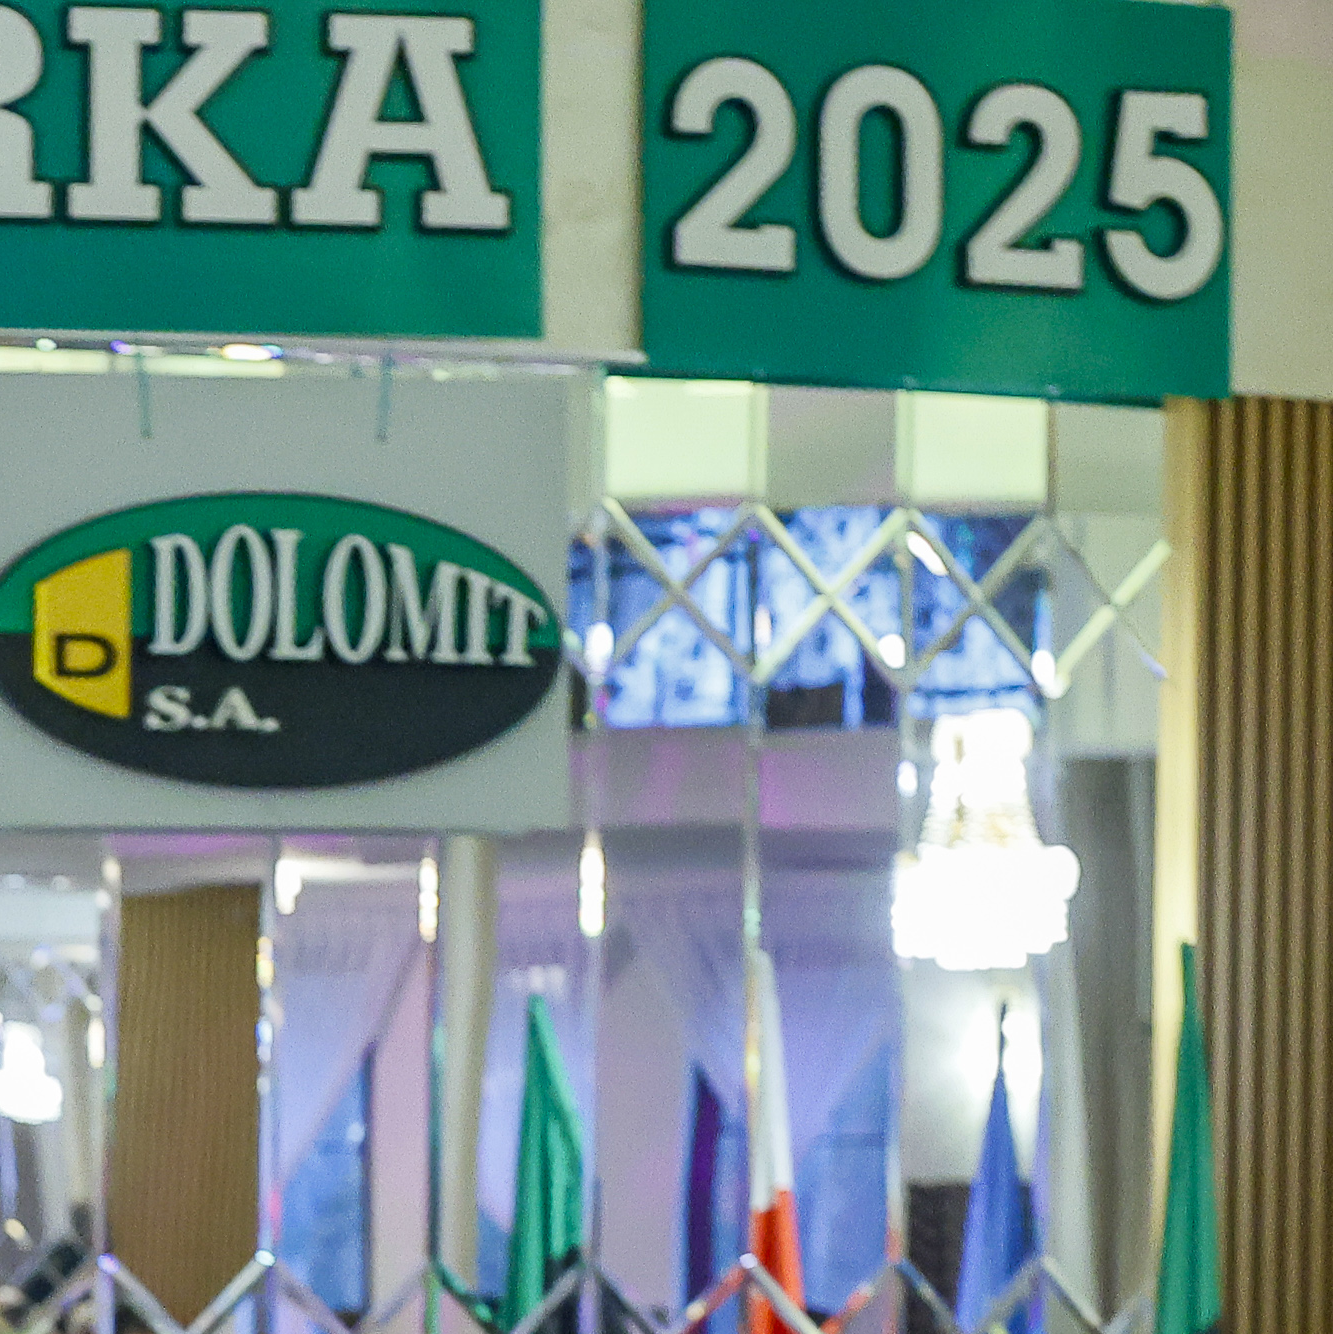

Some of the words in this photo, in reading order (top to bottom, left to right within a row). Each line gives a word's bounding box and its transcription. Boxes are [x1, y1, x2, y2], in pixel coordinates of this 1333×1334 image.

[669, 57, 1224, 300] 2025
[148, 524, 549, 667] DOLOMIT
[54, 633, 116, 678] D
[144, 684, 281, 732] S.A.
